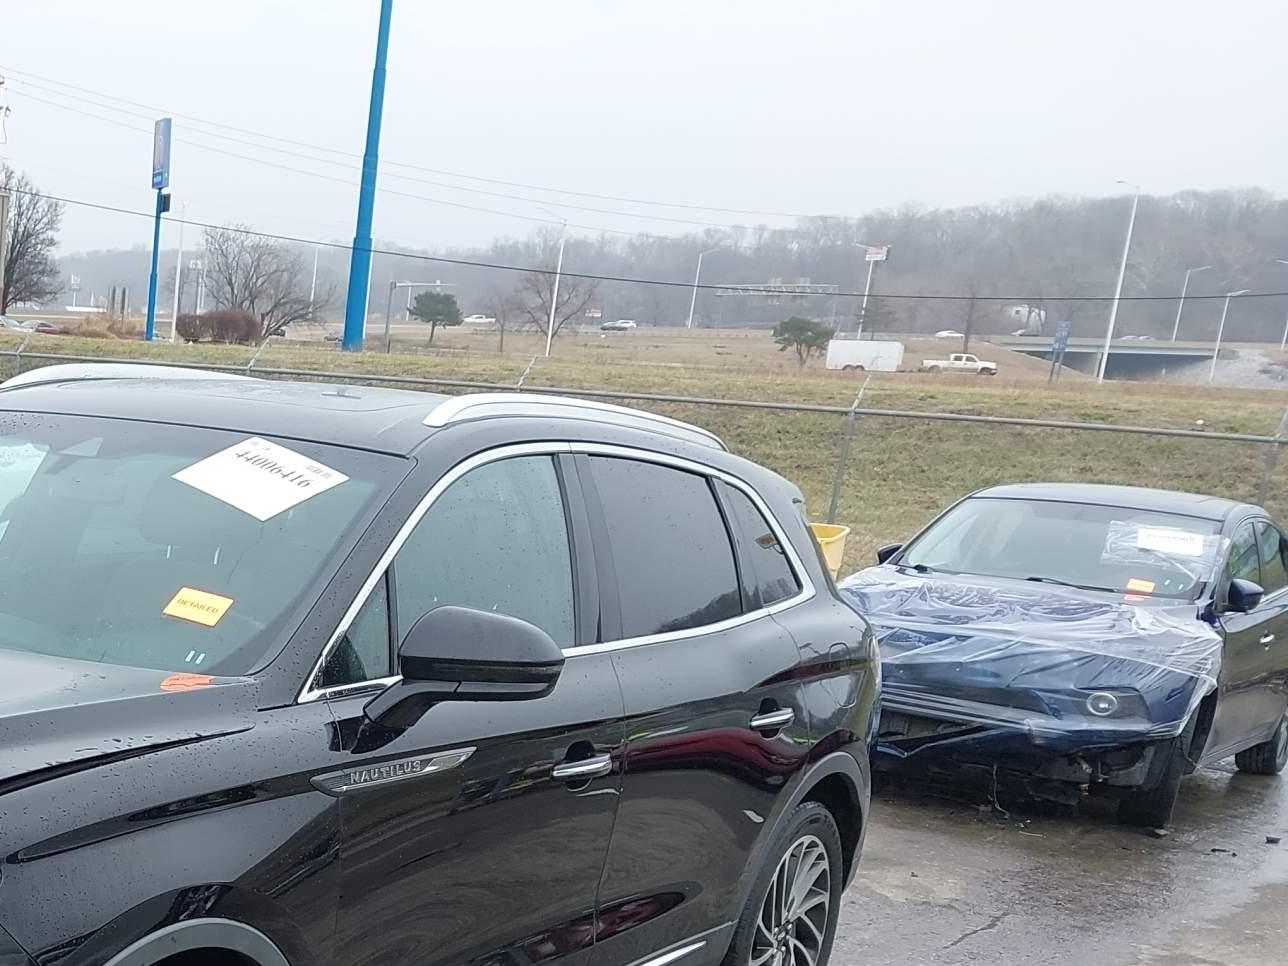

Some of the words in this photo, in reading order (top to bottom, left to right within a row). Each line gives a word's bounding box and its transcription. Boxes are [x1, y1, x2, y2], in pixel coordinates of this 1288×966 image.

[234, 450, 312, 489] 44006416
[176, 598, 220, 614] DETAILED
[350, 759, 423, 785] NAUTILUS
